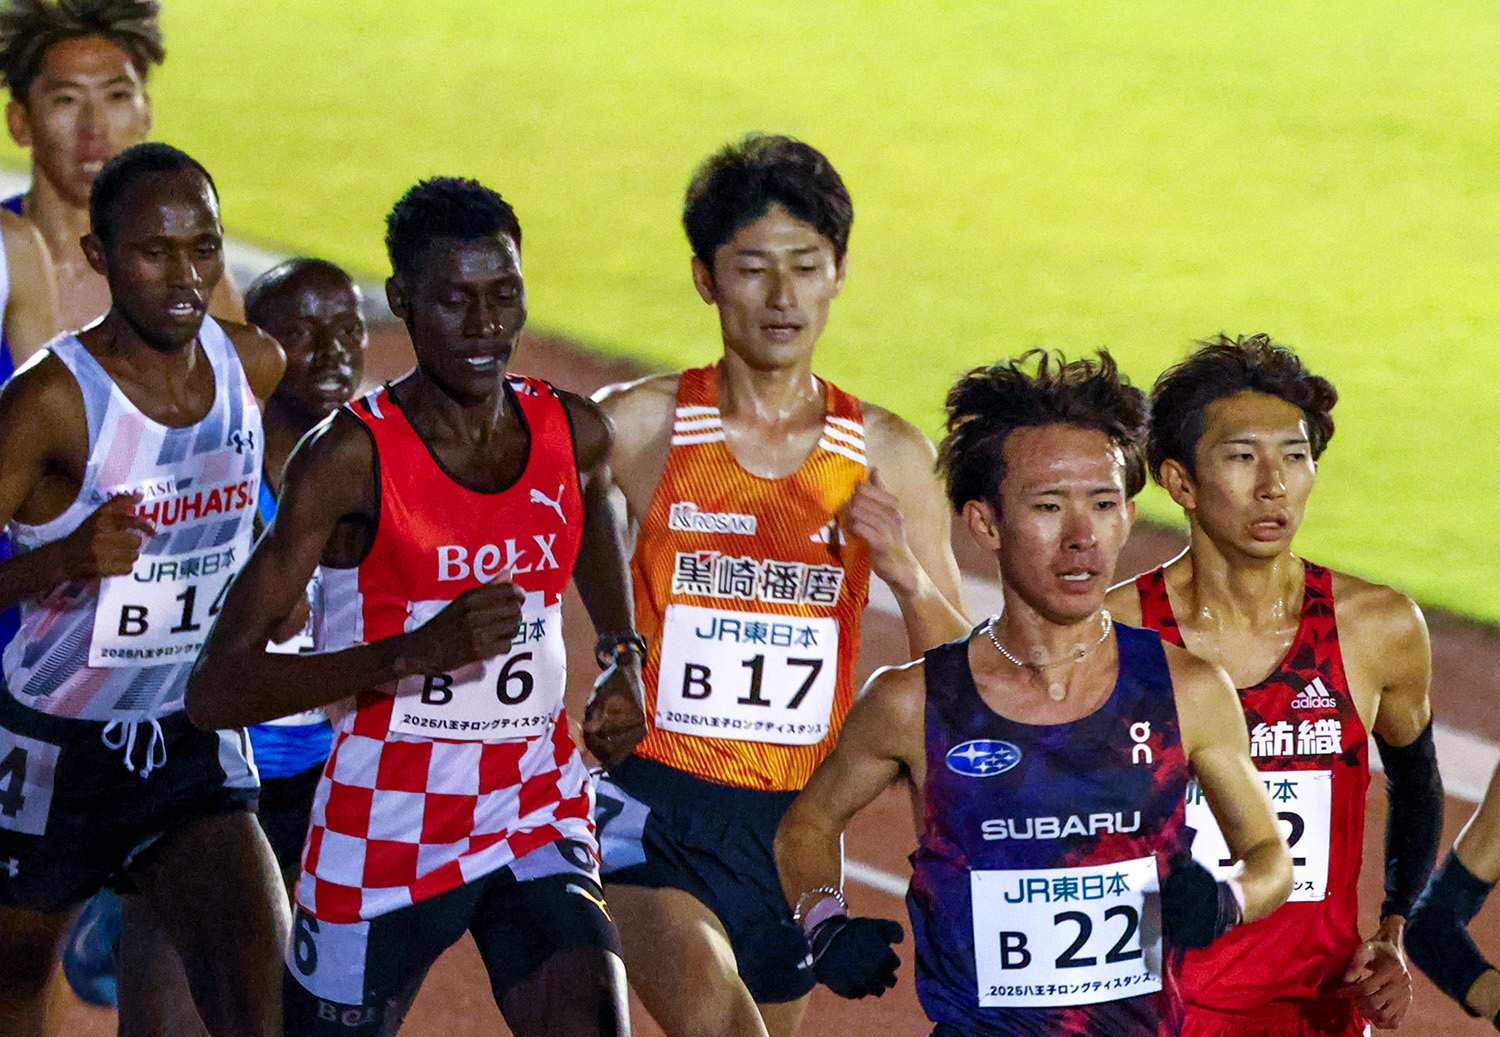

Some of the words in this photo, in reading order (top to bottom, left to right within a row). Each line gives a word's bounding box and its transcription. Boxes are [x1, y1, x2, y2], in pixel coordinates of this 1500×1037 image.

[675, 554, 843, 604] 黒崎播磨
[118, 605, 149, 636] B
[696, 617, 820, 648] JR東日本
[421, 673, 454, 706] B
[496, 651, 534, 706] 6
[682, 663, 712, 700] B
[737, 654, 824, 710] 17
[1290, 696, 1337, 710] adidas
[981, 811, 1141, 842] SUBARU
[1004, 871, 1130, 904] JR東日本
[1000, 931, 1032, 970] B
[1053, 905, 1143, 970] 22
